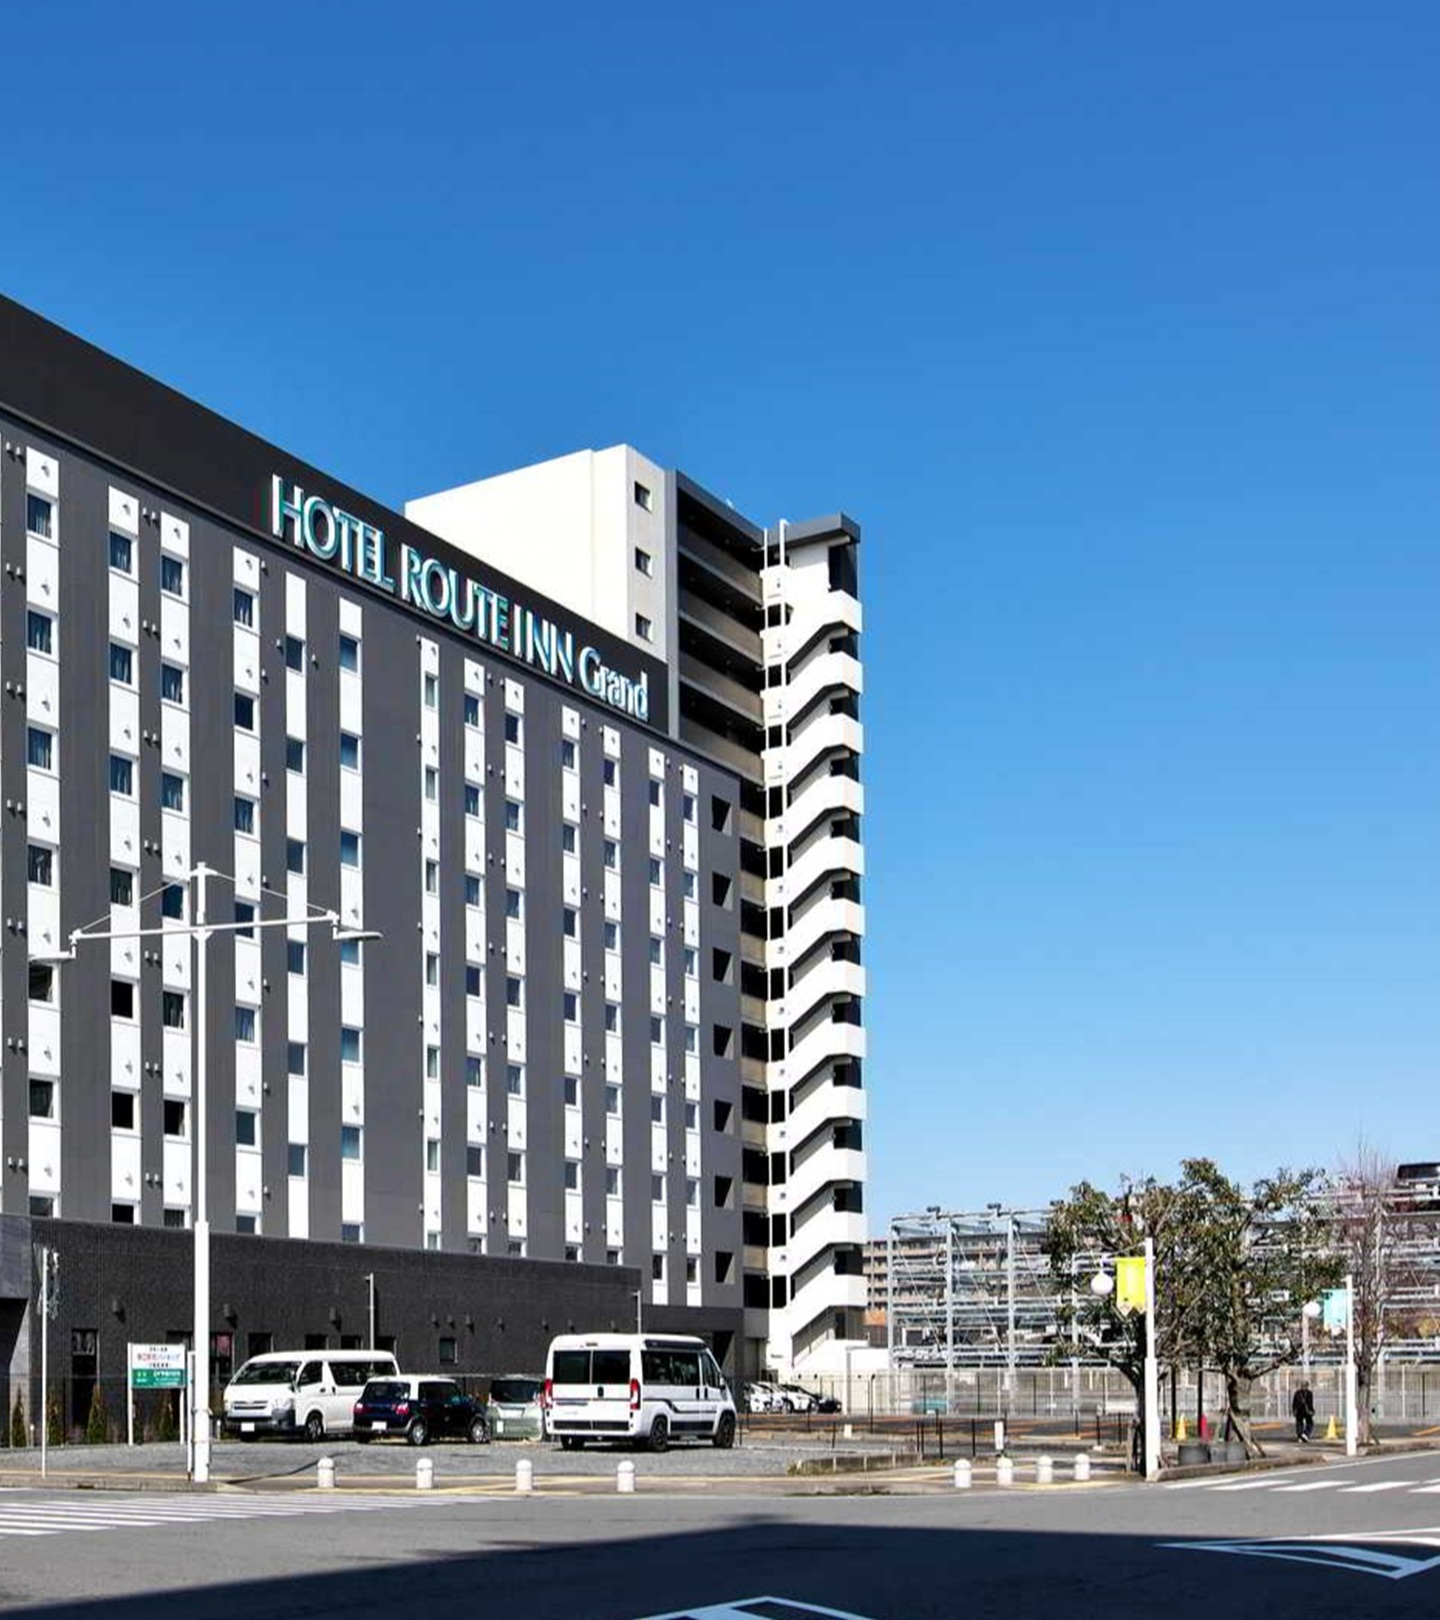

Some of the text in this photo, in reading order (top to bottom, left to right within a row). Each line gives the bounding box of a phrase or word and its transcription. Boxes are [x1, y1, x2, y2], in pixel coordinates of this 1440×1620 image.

[272, 473, 649, 722] HOTEL ROUTE INN Grand
